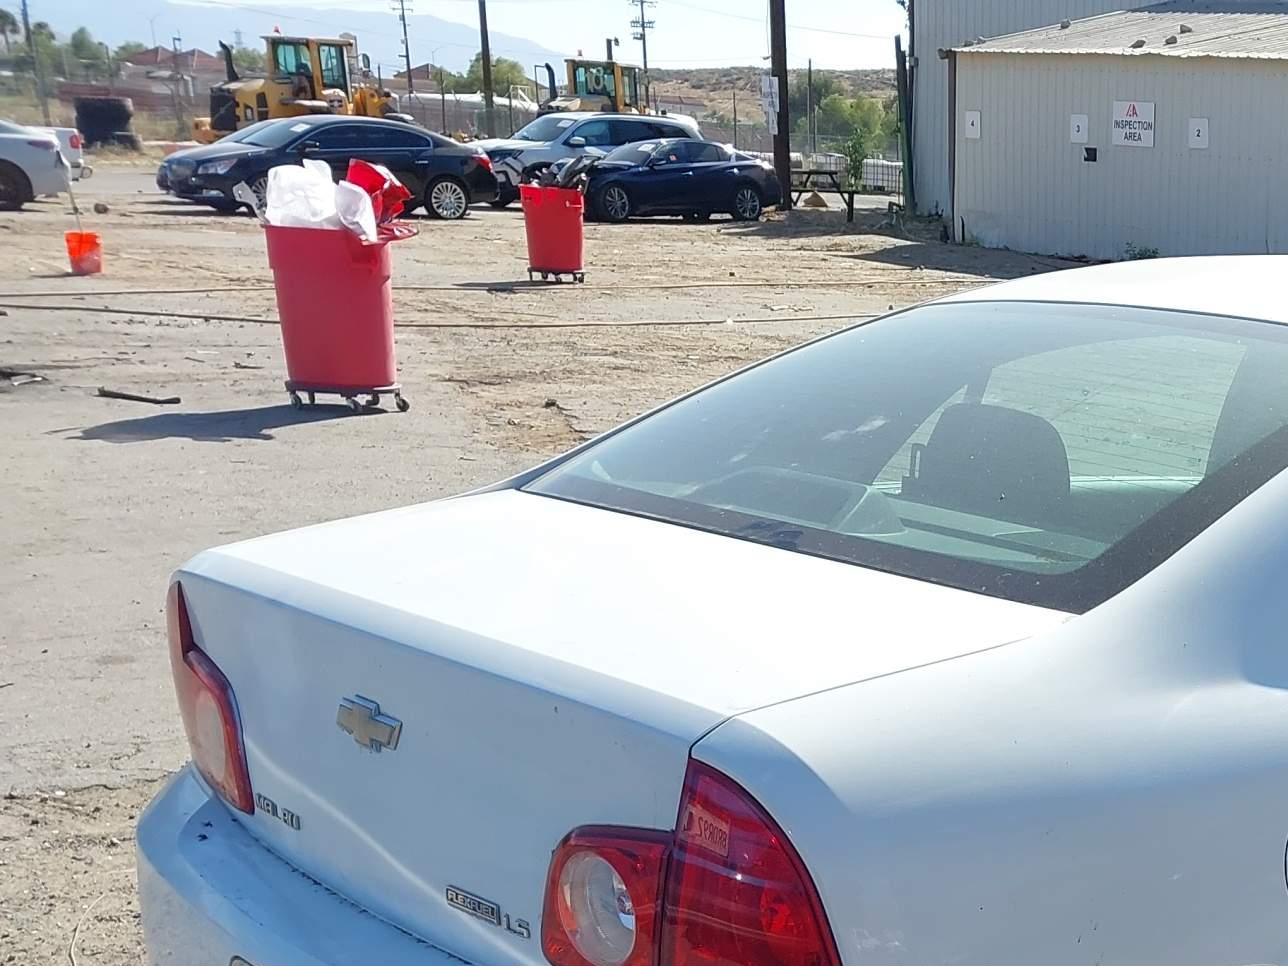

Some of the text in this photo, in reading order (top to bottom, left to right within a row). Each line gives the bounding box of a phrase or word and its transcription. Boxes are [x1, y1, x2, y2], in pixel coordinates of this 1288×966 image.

[1113, 120, 1153, 131] INSPECTION
[1123, 131, 1142, 142] AREA
[503, 911, 532, 939] LS
